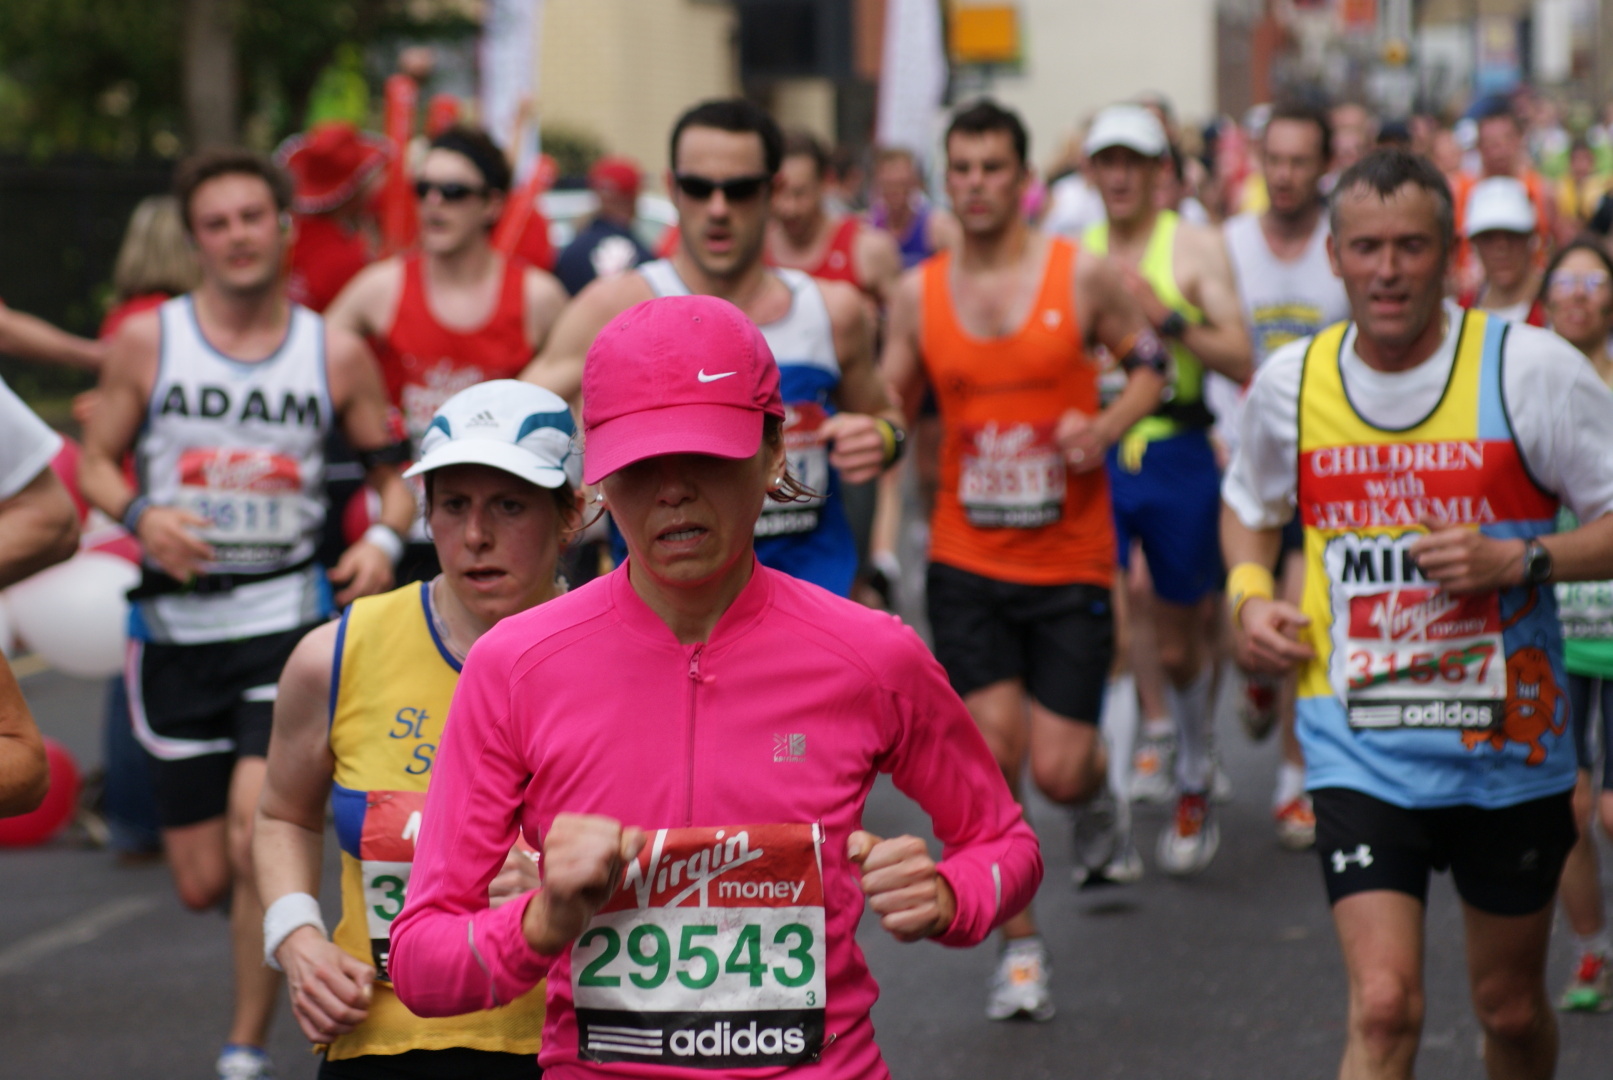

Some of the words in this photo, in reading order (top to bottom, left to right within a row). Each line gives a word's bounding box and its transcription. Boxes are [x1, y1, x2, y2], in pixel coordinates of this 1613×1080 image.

[161, 383, 321, 428] ADAM
[1311, 441, 1484, 478] CHILDREN
[1364, 470, 1425, 500] with
[1341, 549, 1429, 583] MIK
[1368, 588, 1460, 642] Virgin
[1348, 643, 1497, 690] 31567
[389, 707, 430, 739] St
[1402, 701, 1493, 728] adidas
[404, 743, 437, 775] S
[622, 829, 764, 908] Virgin
[718, 880, 805, 904] money
[577, 923, 816, 990] 29543
[805, 991, 817, 1008] 3
[669, 1020, 806, 1057] adidas
